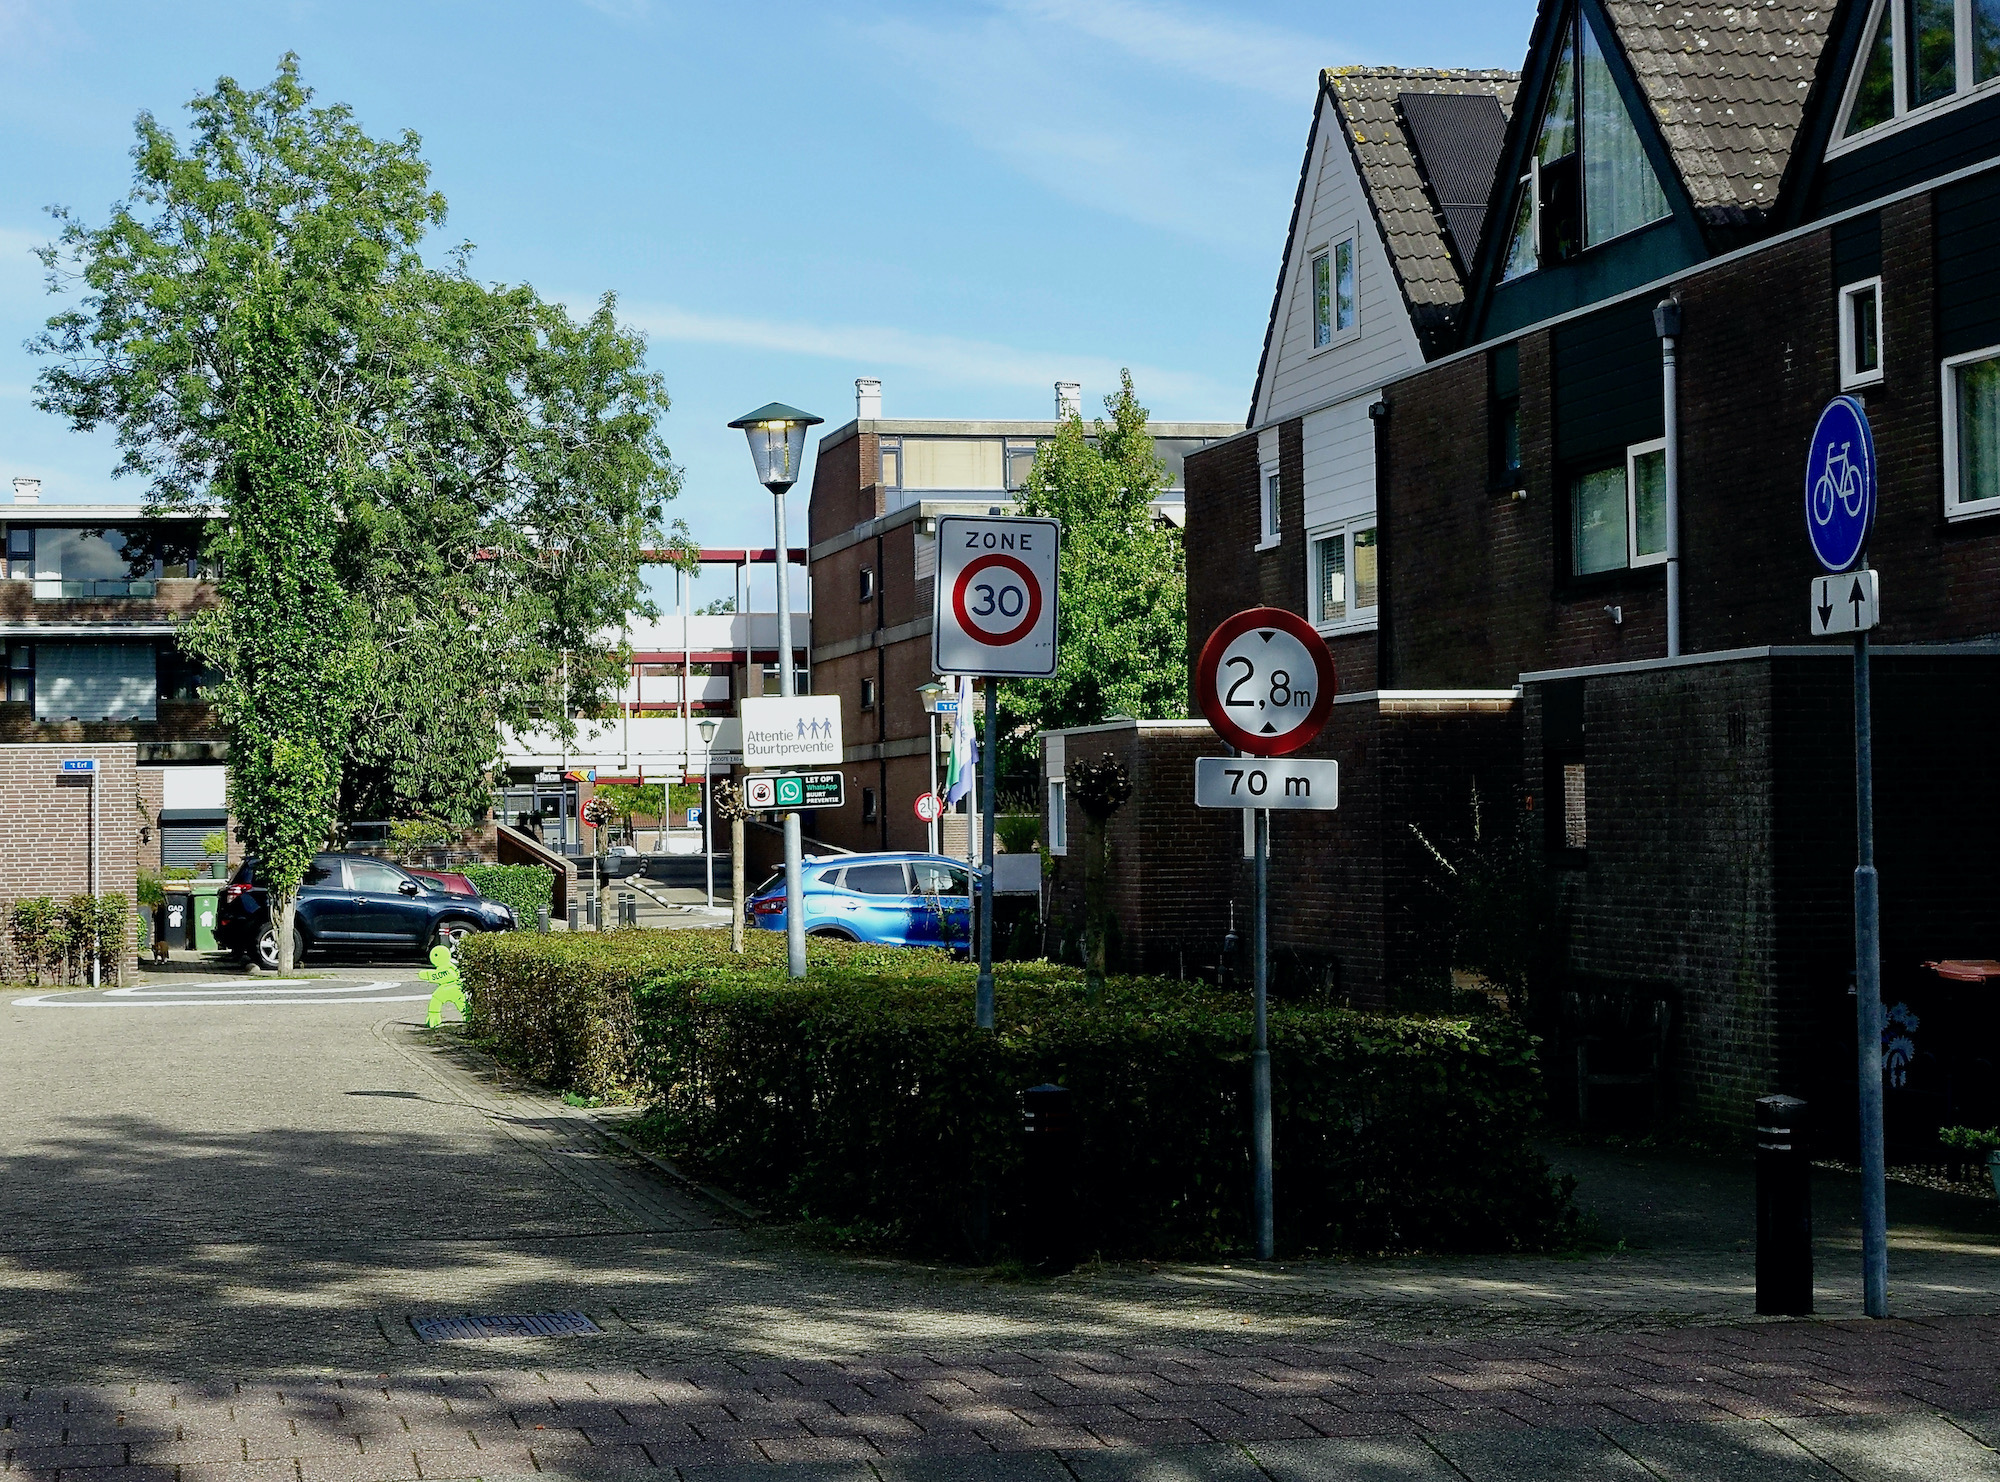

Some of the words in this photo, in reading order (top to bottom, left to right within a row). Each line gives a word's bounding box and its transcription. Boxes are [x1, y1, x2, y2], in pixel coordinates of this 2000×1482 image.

[965, 531, 1032, 551] ZONE
[971, 584, 1024, 617] 30
[747, 729, 794, 742] Attentie
[747, 740, 834, 756] Buurtpreventie
[77, 761, 88, 769] Erf
[805, 776, 819, 784] LET
[1224, 769, 1268, 796] 70
[1285, 776, 1311, 797] m
[167, 904, 184, 912] GAD
